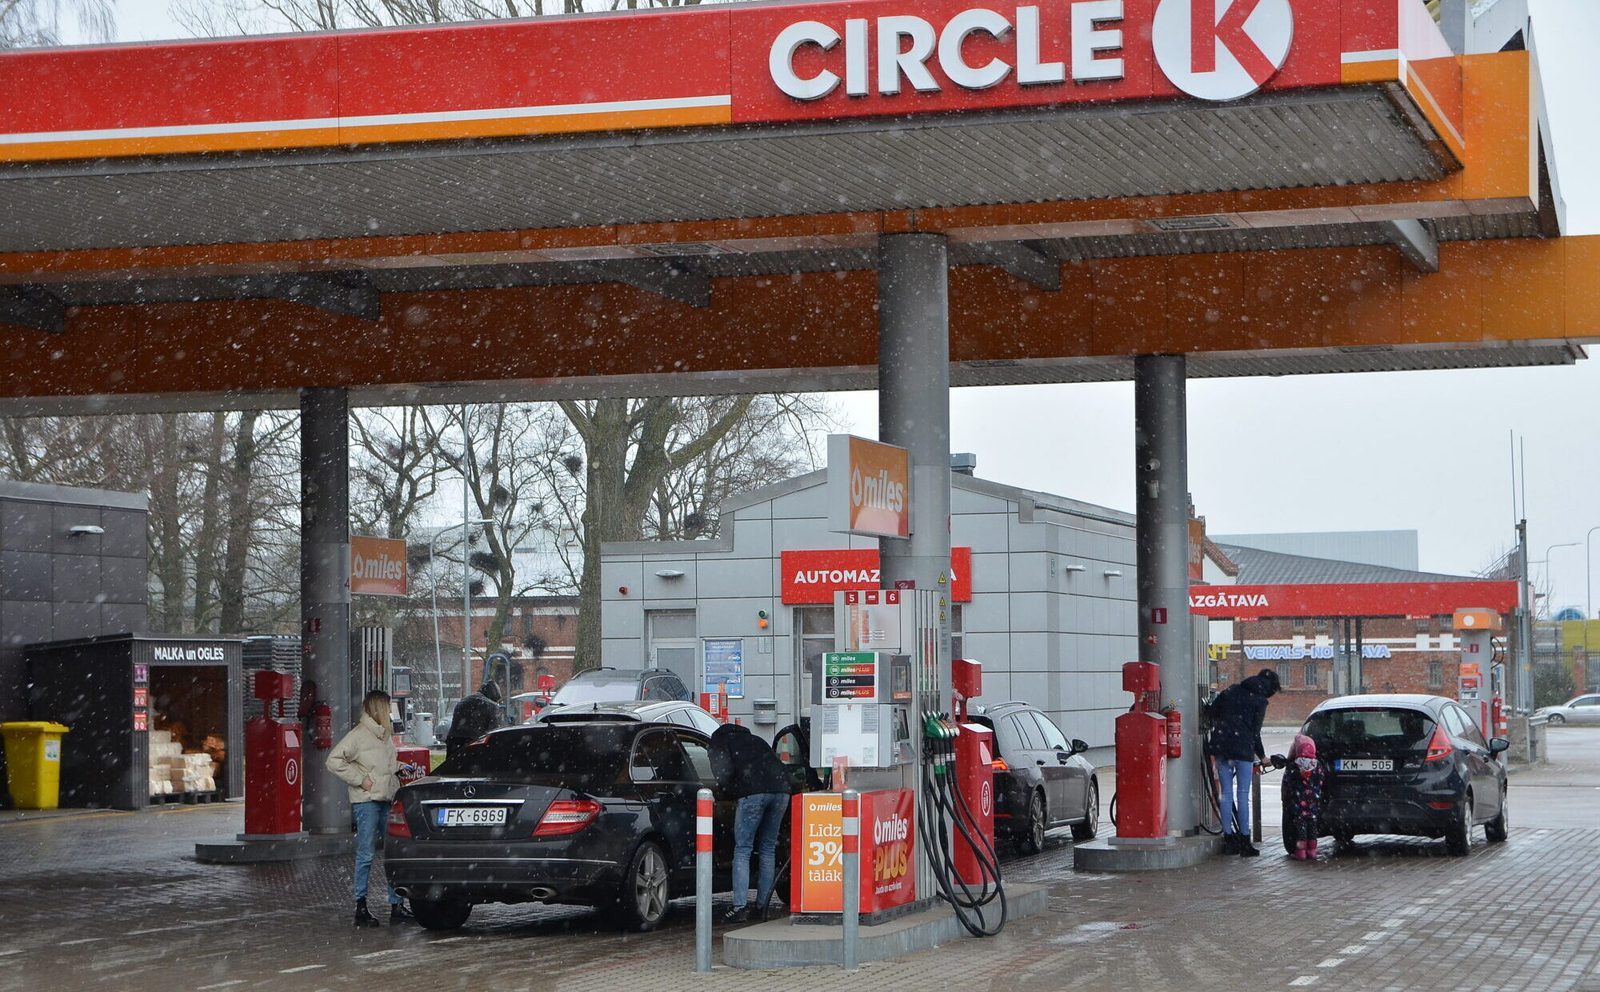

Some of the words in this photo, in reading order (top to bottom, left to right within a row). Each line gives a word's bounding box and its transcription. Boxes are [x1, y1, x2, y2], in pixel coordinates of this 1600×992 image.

[769, 1, 1125, 100] CIRCLE
[1190, 0, 1283, 88] K
[863, 469, 903, 513] miles
[365, 554, 402, 579] miles
[849, 593, 855, 602] 5
[889, 592, 896, 601] 6
[154, 647, 184, 660] MALKA
[186, 649, 196, 660] un
[197, 647, 224, 660] OGLES
[1244, 644, 1392, 660] VEIKALS-NOAVA
[817, 803, 842, 811] miles
[447, 809, 504, 823] FK-6969
[809, 823, 842, 837] Līdz
[881, 814, 908, 843] miles
[808, 841, 843, 867] 3%
[874, 842, 908, 882] PLUS
[809, 869, 842, 882] tālāk
